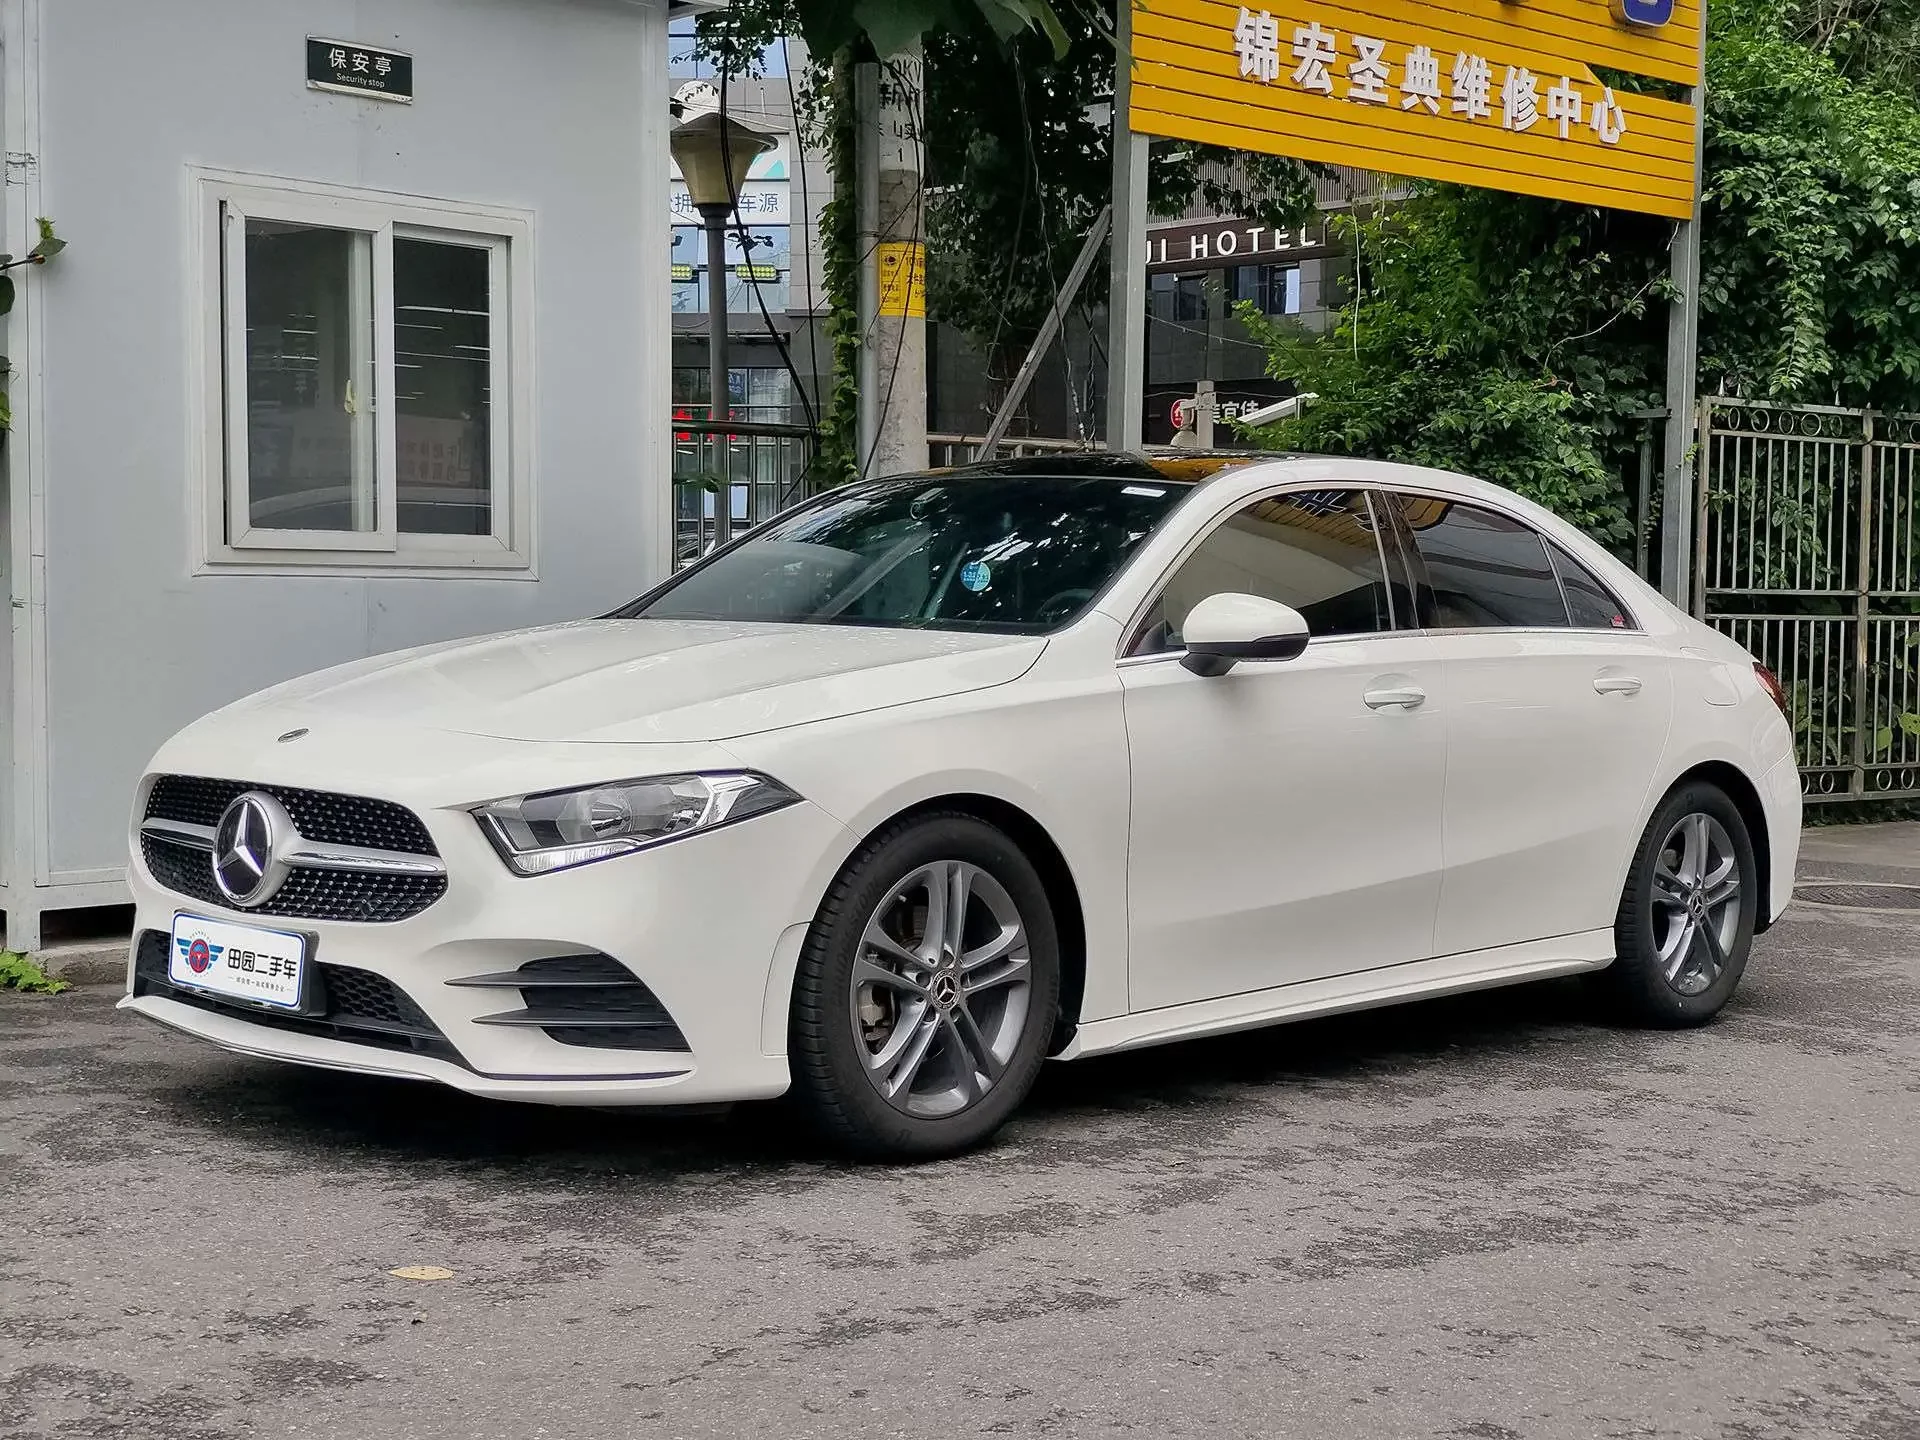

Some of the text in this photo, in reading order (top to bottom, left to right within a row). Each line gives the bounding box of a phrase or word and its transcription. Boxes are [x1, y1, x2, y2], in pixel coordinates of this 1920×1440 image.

[329, 47, 391, 75] 保安亭
[1233, 6, 1627, 144] 锦宏圣典维修中心
[337, 73, 385, 88] Security stop
[1190, 222, 1316, 259] HOTEL
[228, 948, 297, 979] 田园二手车
